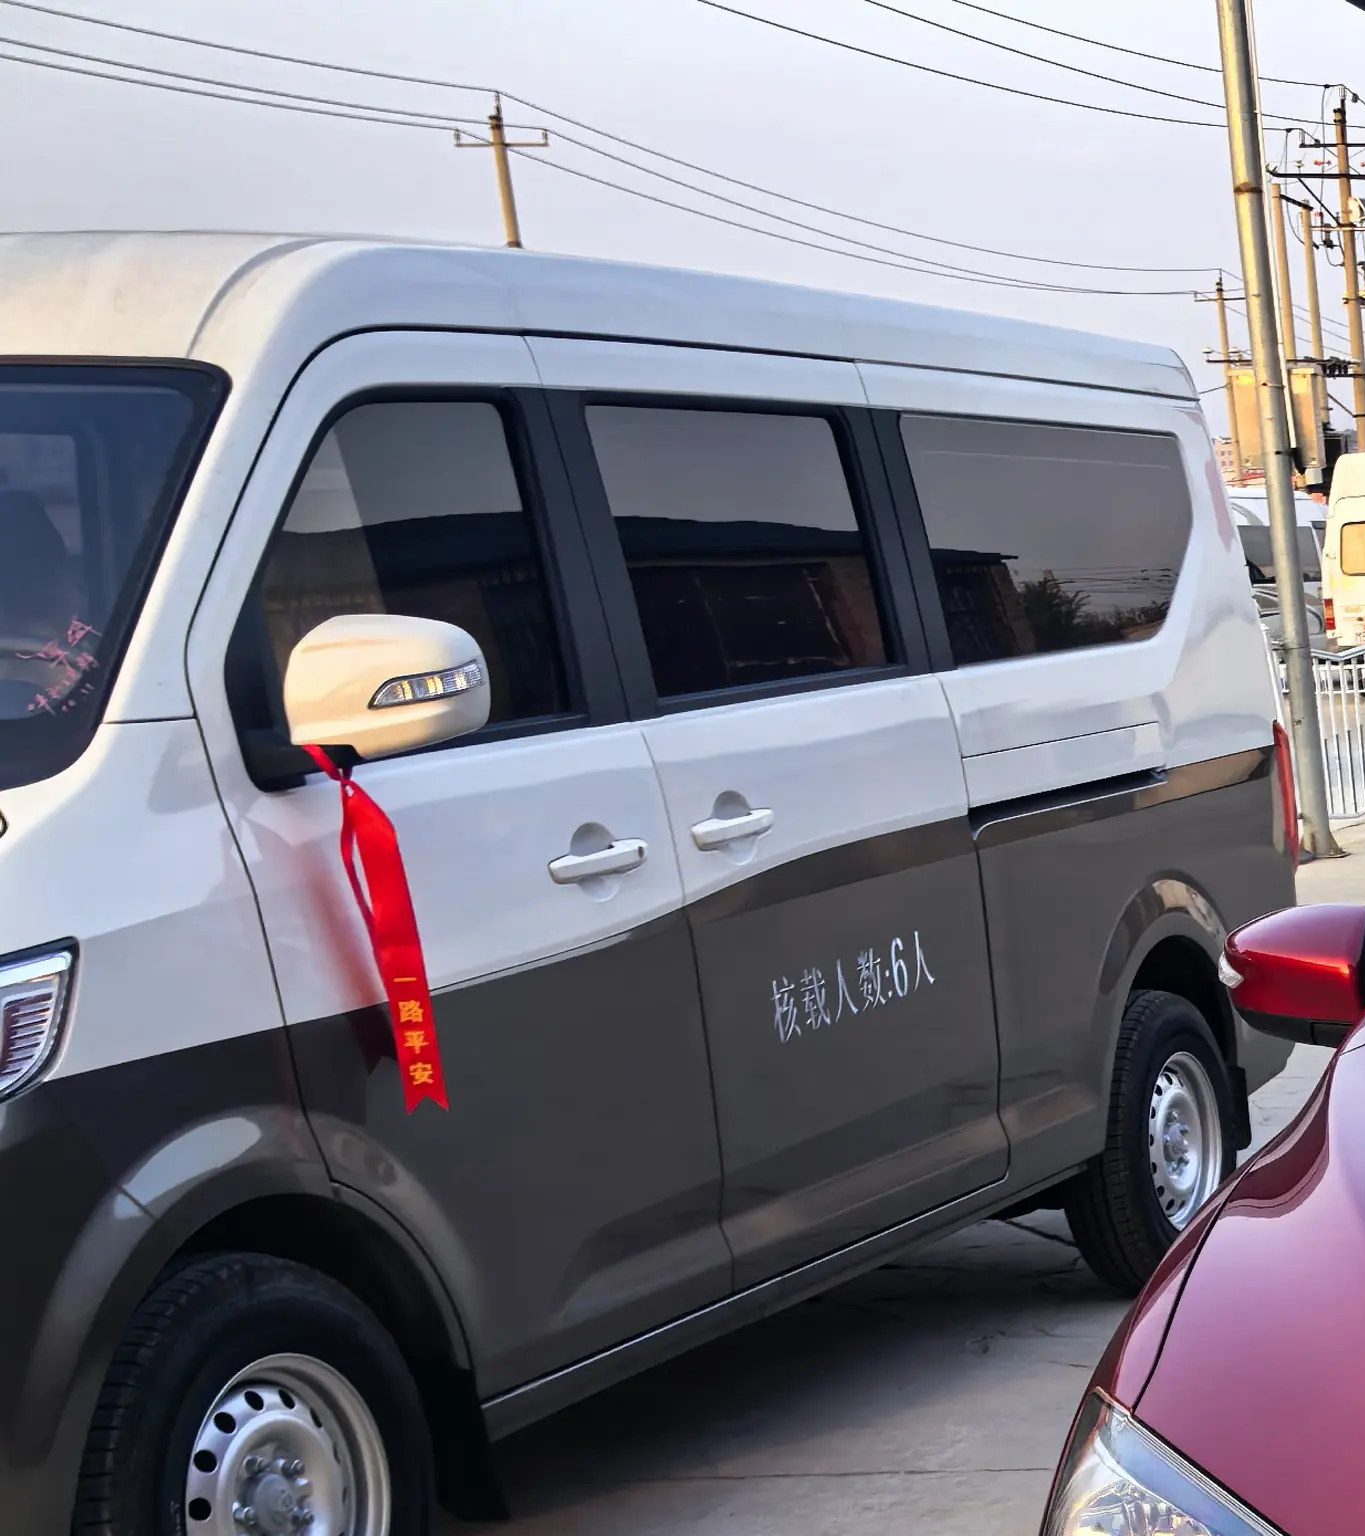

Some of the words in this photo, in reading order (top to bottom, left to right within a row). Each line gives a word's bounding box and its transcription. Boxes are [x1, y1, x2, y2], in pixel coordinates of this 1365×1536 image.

[393, 976, 434, 1085] 一路平安
[771, 930, 935, 1043] 核载人数:6人
